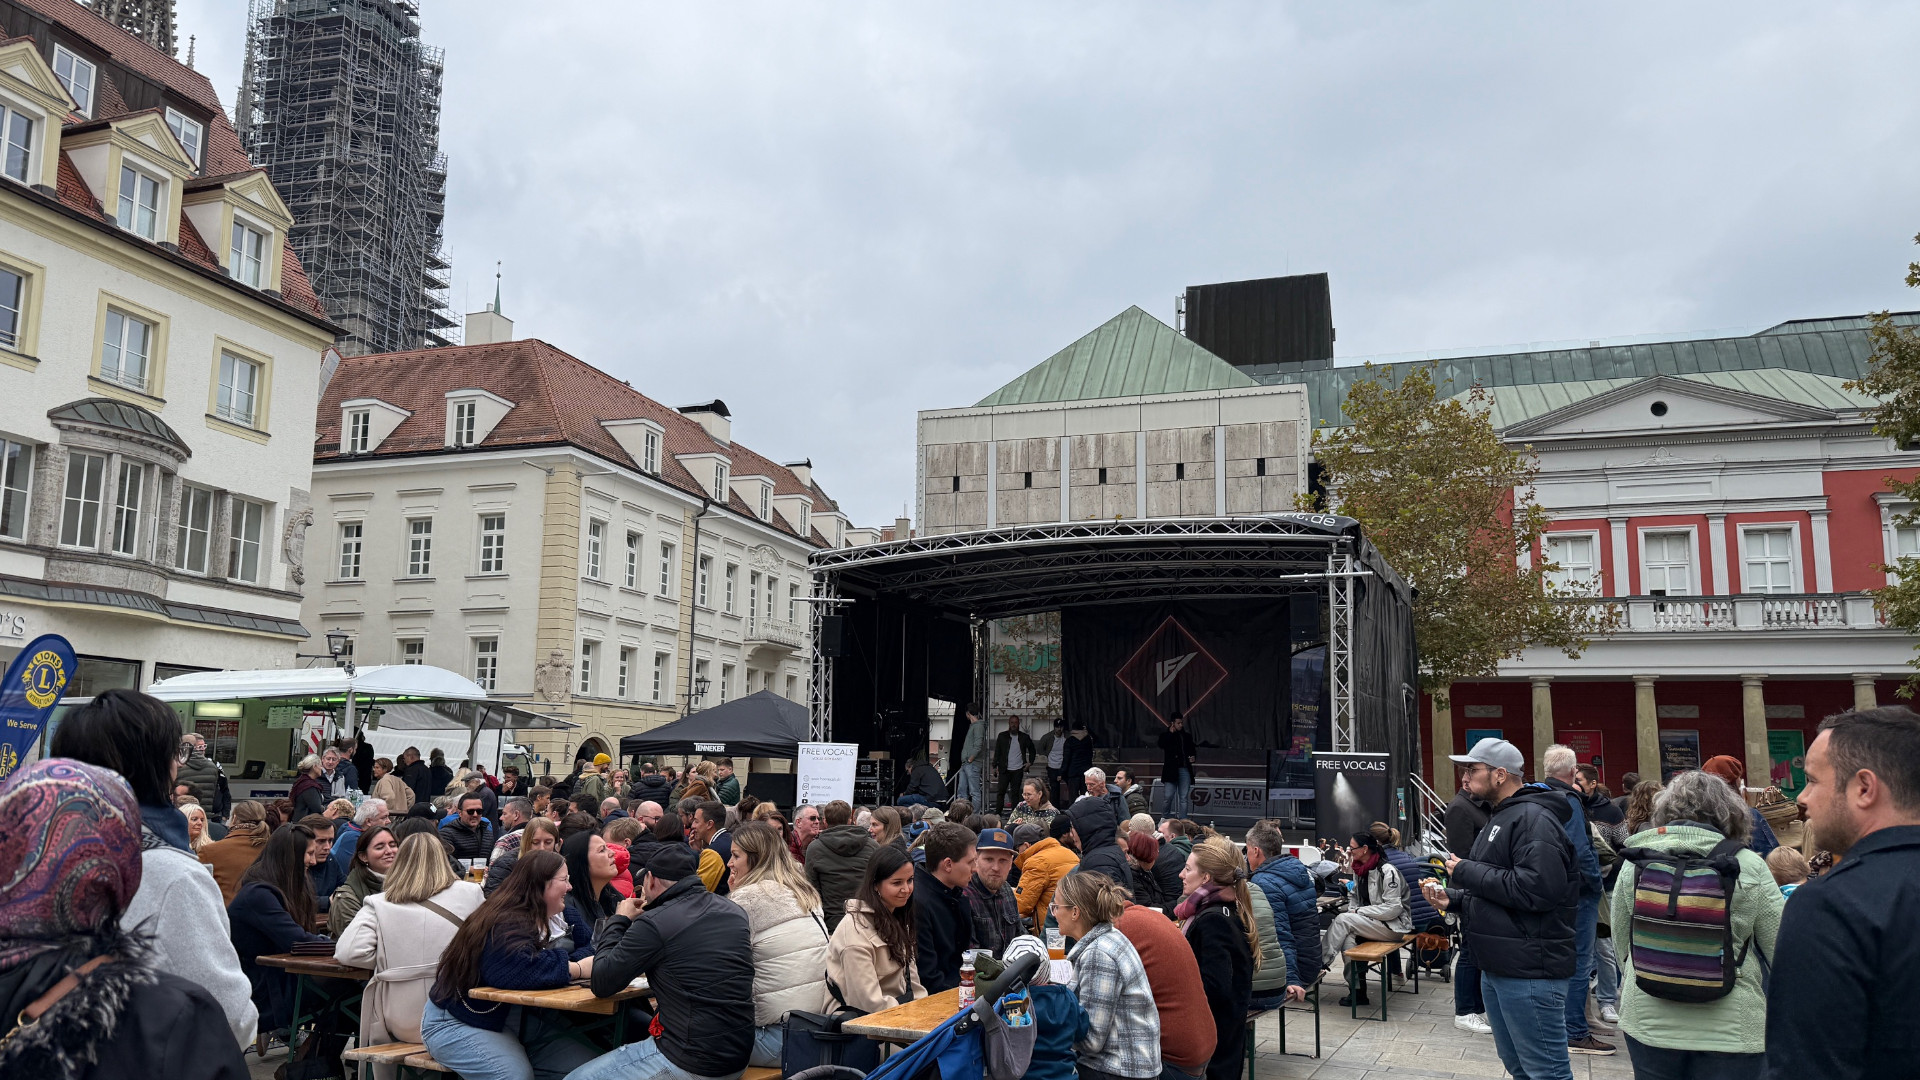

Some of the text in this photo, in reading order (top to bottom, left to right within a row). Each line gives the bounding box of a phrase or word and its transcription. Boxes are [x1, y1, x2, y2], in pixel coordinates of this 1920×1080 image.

[35, 652, 61, 667] LIONS
[38, 667, 51, 690] L
[7, 719, 38, 730] We Serve
[693, 742, 727, 752] TENNEKER
[801, 747, 854, 756] FREE VOCALS
[1316, 760, 1386, 771] FREE VOCALS
[1214, 788, 1262, 801] SEVEN
